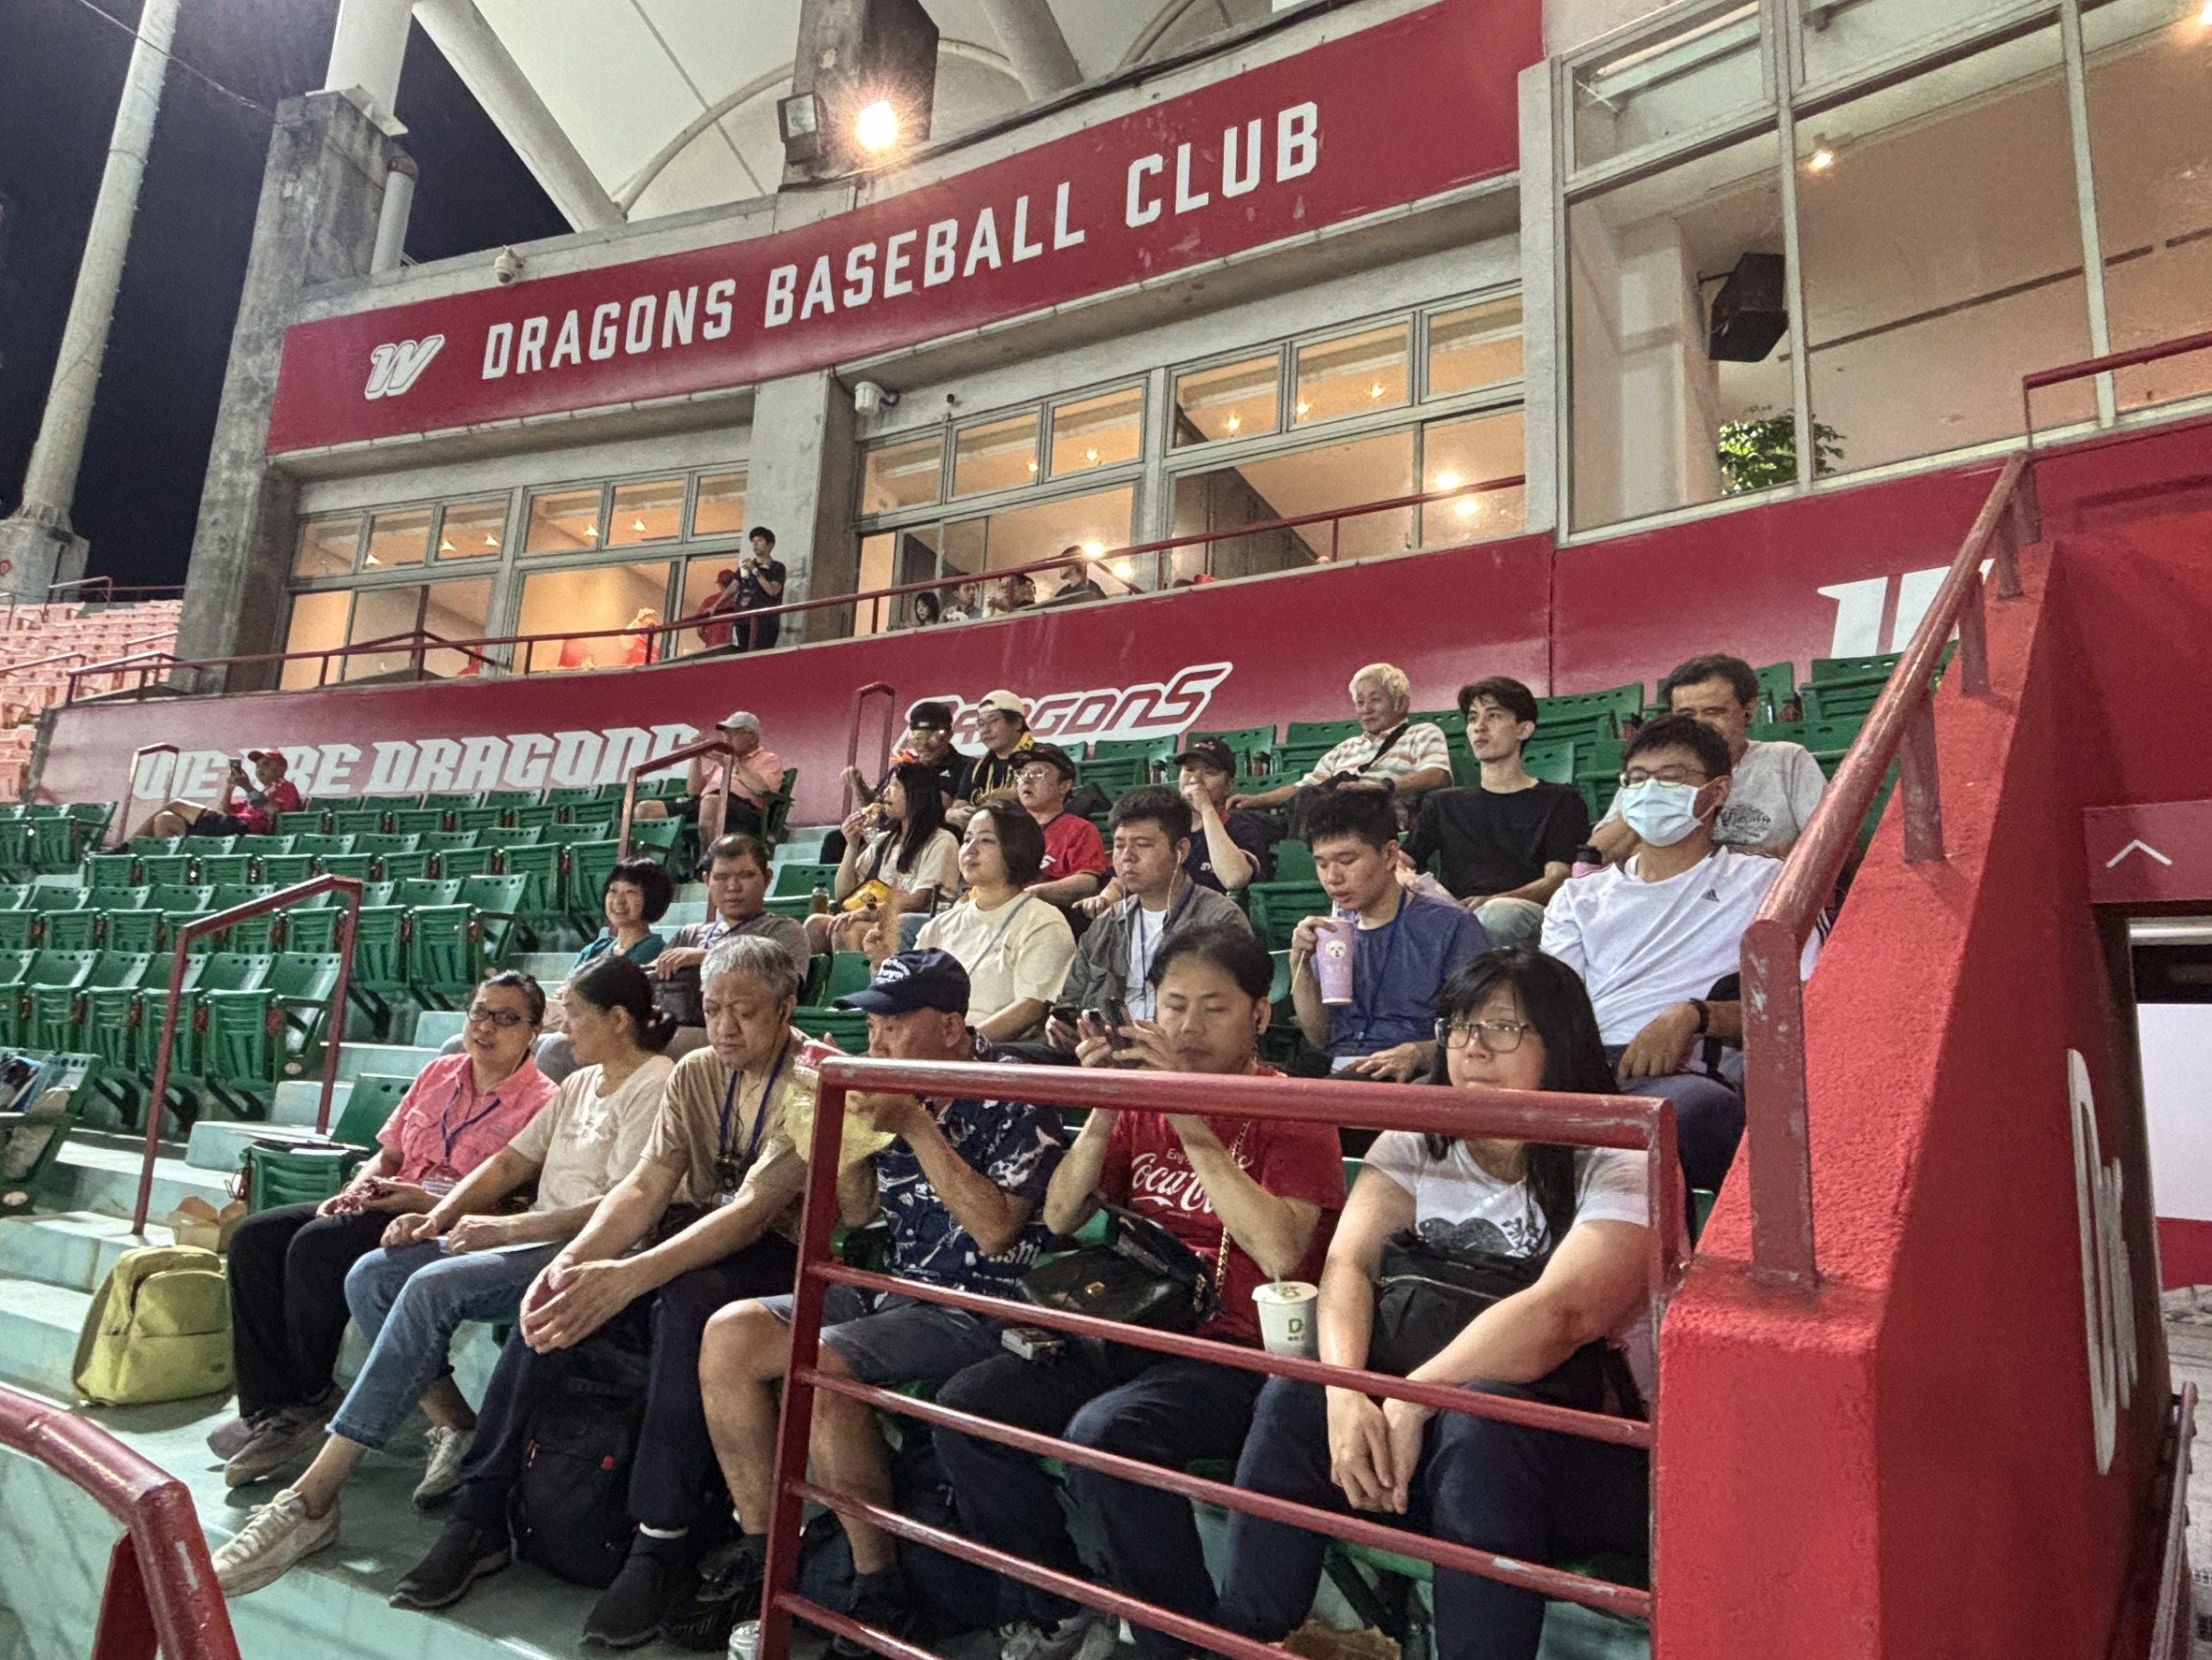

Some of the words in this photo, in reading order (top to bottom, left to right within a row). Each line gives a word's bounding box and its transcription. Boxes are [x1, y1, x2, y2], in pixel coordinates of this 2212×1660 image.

[482, 278, 736, 380] DRAGONS
[764, 182, 1085, 328] BASEBALL
[1126, 101, 1317, 227] CLUB
[133, 750, 229, 799] WE
